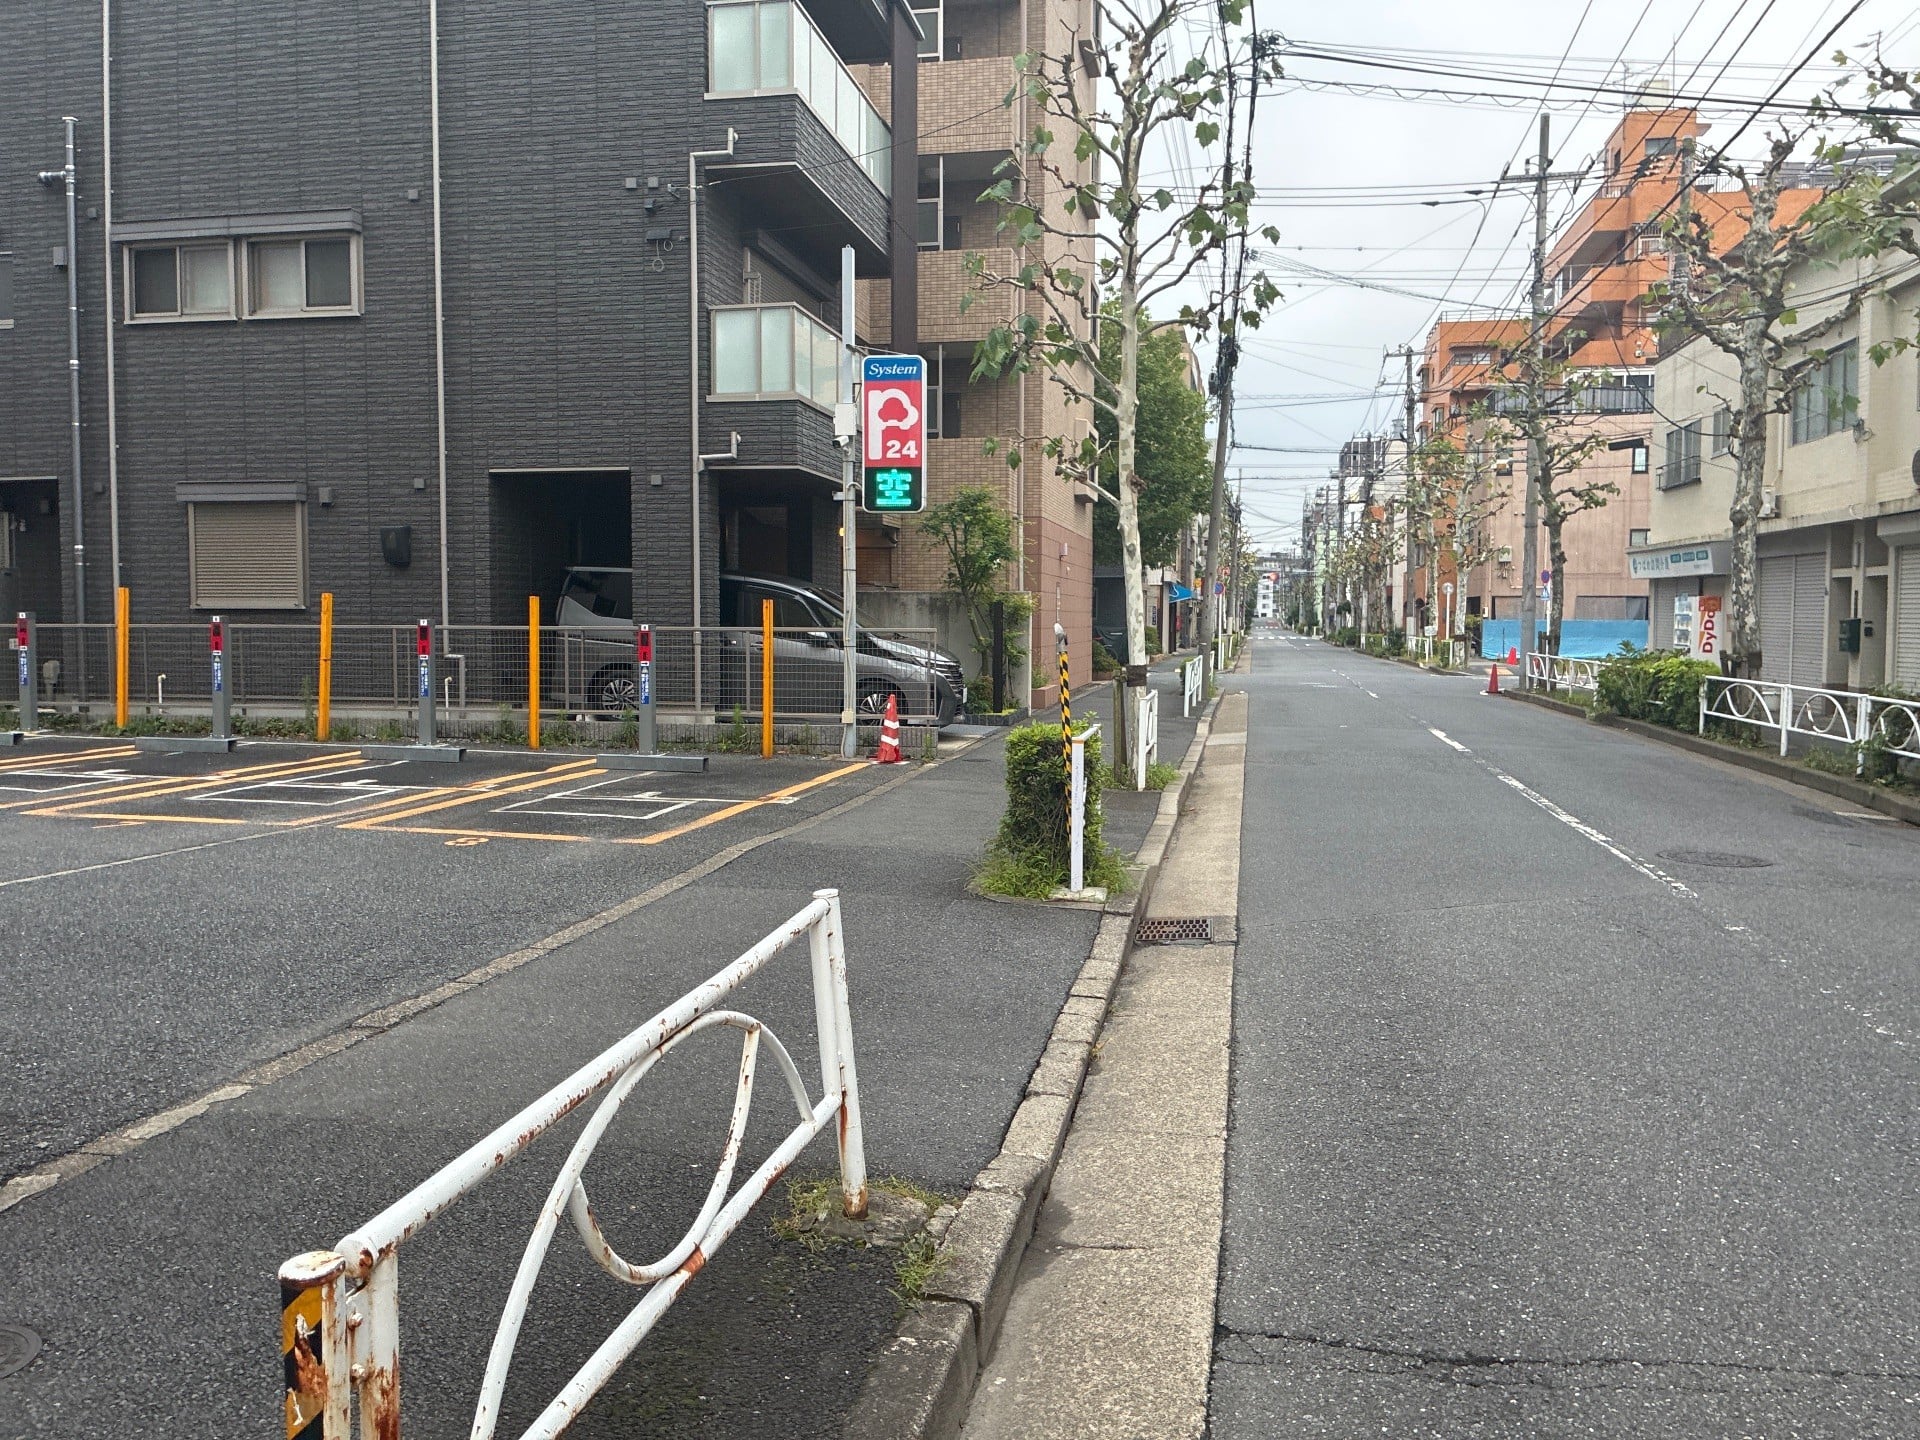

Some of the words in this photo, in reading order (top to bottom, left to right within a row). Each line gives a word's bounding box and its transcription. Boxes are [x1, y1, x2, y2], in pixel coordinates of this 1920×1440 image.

[868, 363, 918, 378] System
[886, 439, 919, 459] 24
[875, 468, 912, 506] 空
